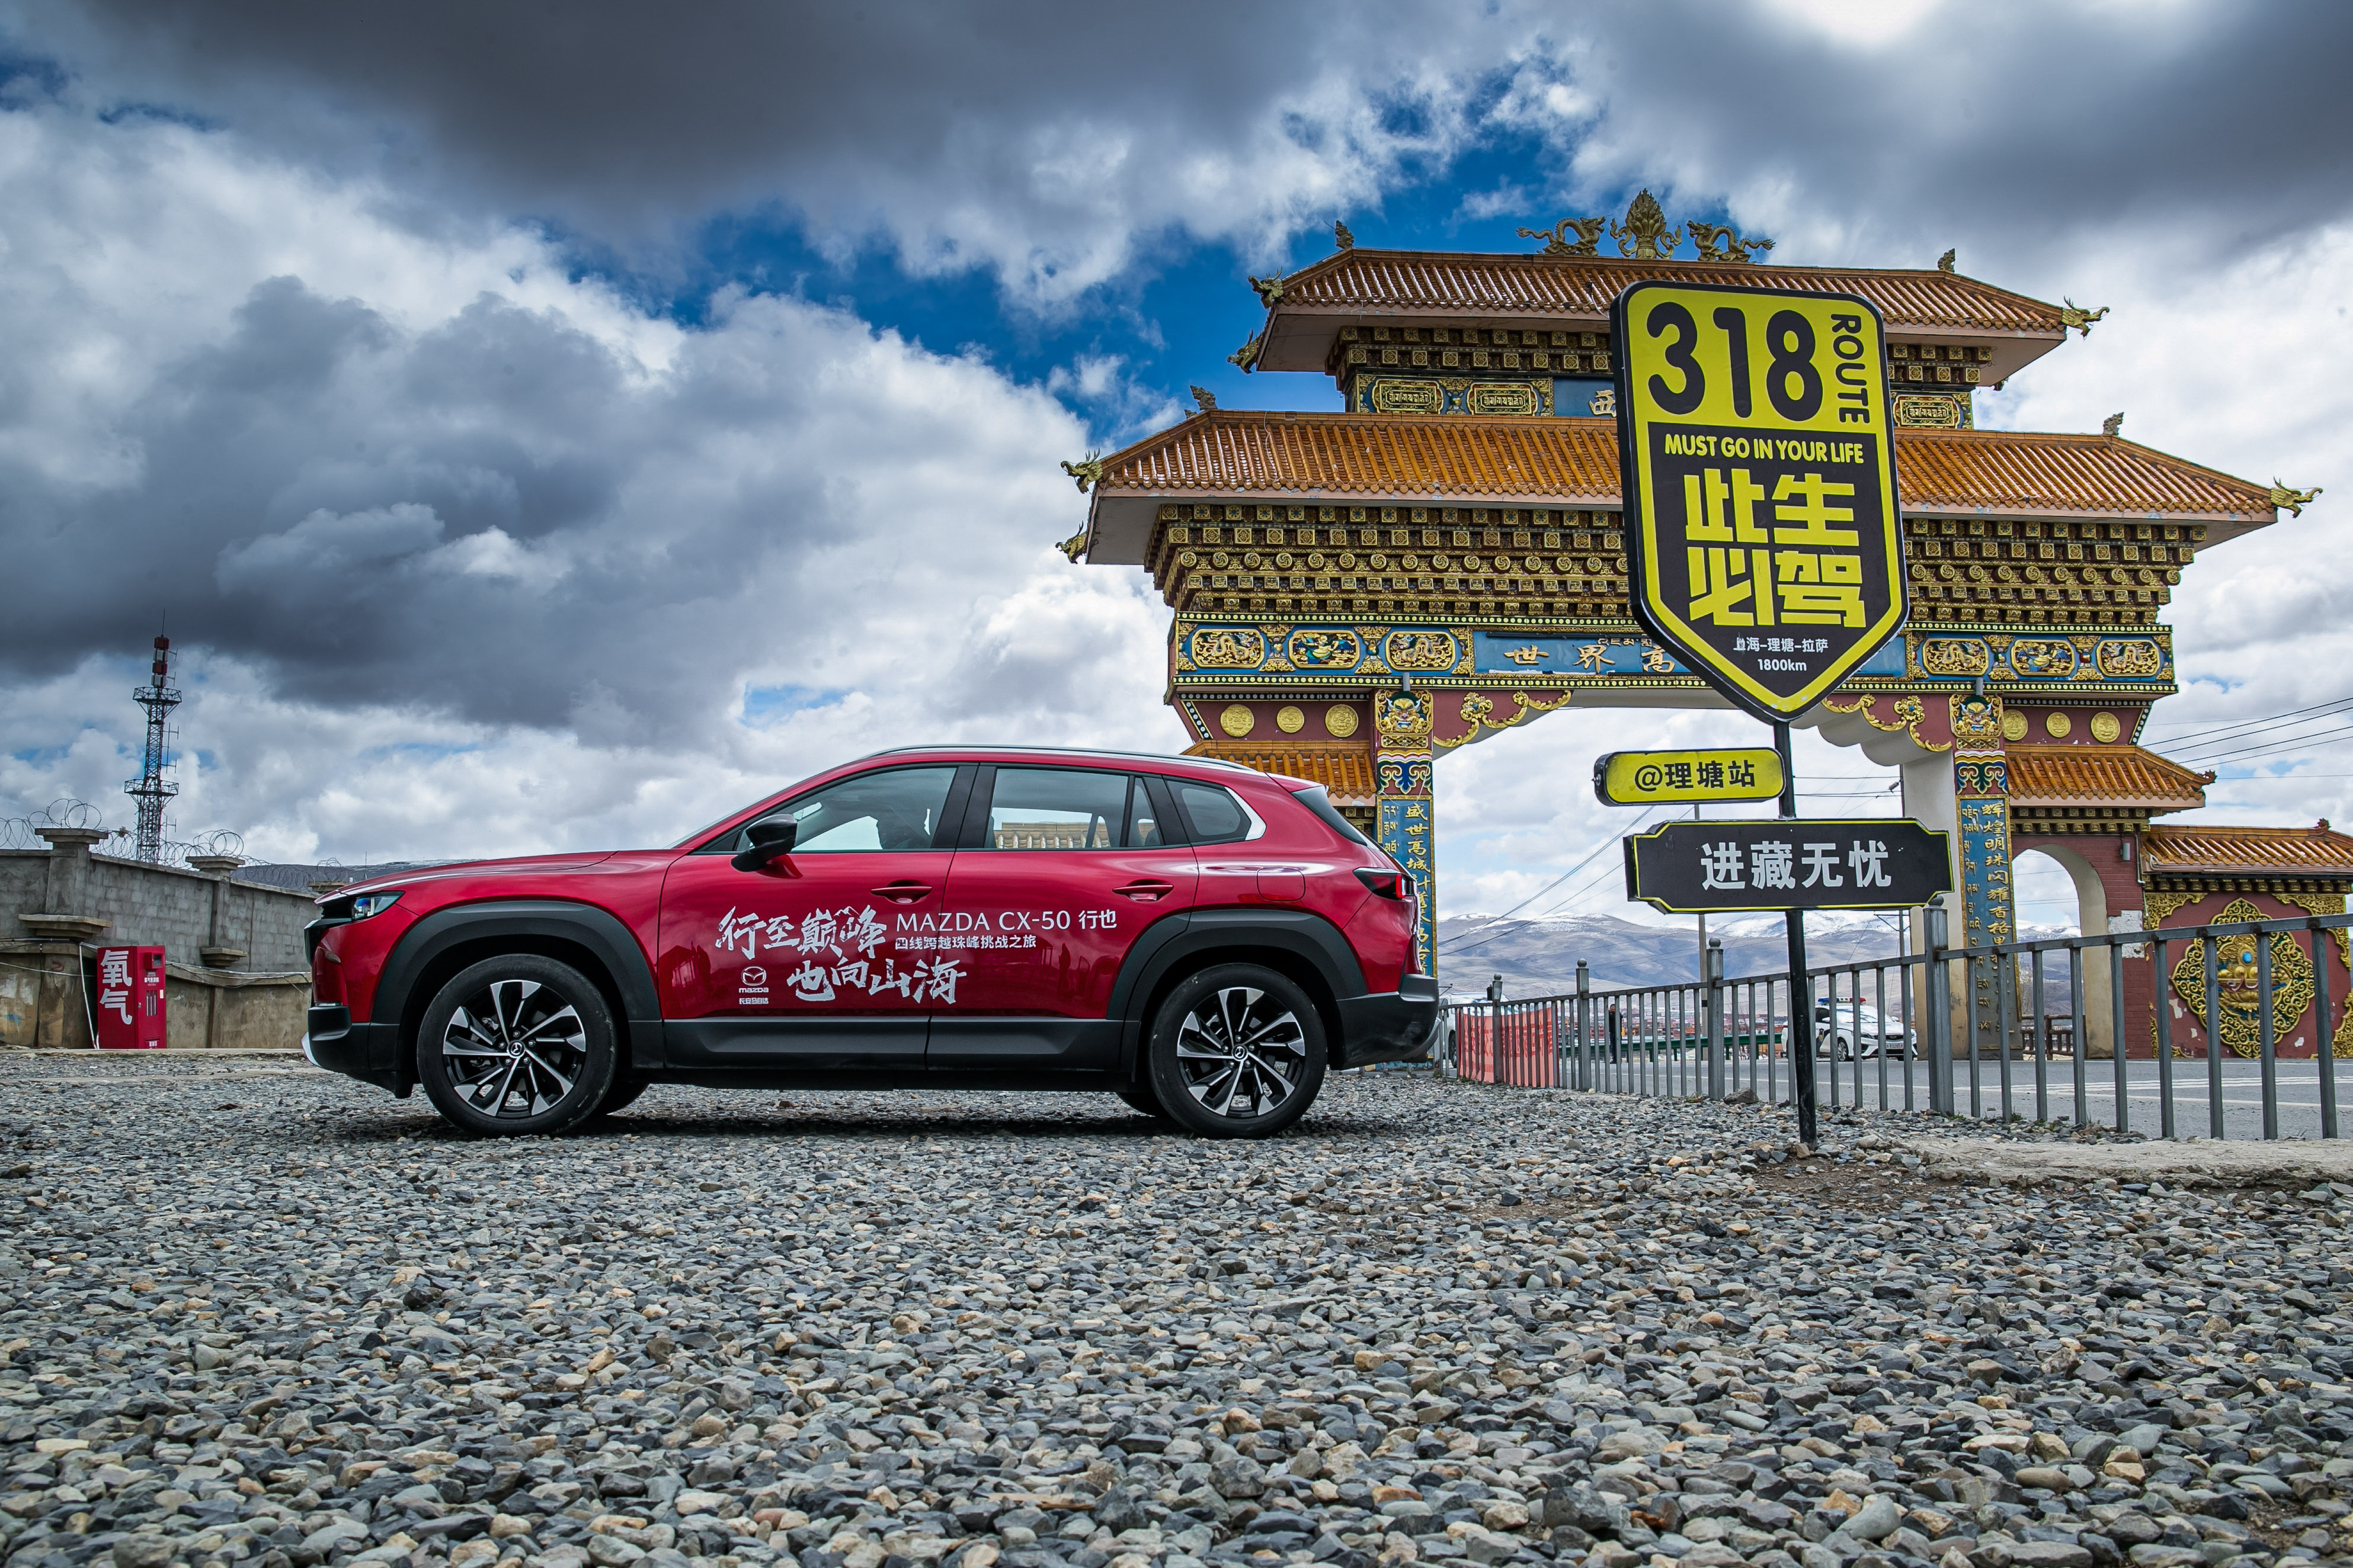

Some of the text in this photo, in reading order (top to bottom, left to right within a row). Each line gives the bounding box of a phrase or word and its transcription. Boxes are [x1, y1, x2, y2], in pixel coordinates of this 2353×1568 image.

[1647, 302, 1823, 422] 318
[1830, 313, 1870, 424] ROUTE
[1665, 434, 1864, 464] MUST GO IN YOUR LIFE
[1684, 468, 1859, 546] 此生
[1688, 546, 1866, 628] 必驾
[1757, 659, 1807, 672] 1800km
[1634, 759, 1756, 793] @理塘站
[1701, 840, 1892, 891] 进藏无忧
[715, 905, 887, 960] 行至巅峰
[895, 934, 1037, 950] 四线跨越珠峰挑战之旅
[896, 909, 1117, 932] MAZDA CX-50 行也
[100, 950, 133, 1025] 氧气
[787, 955, 967, 1005] 也向山海
